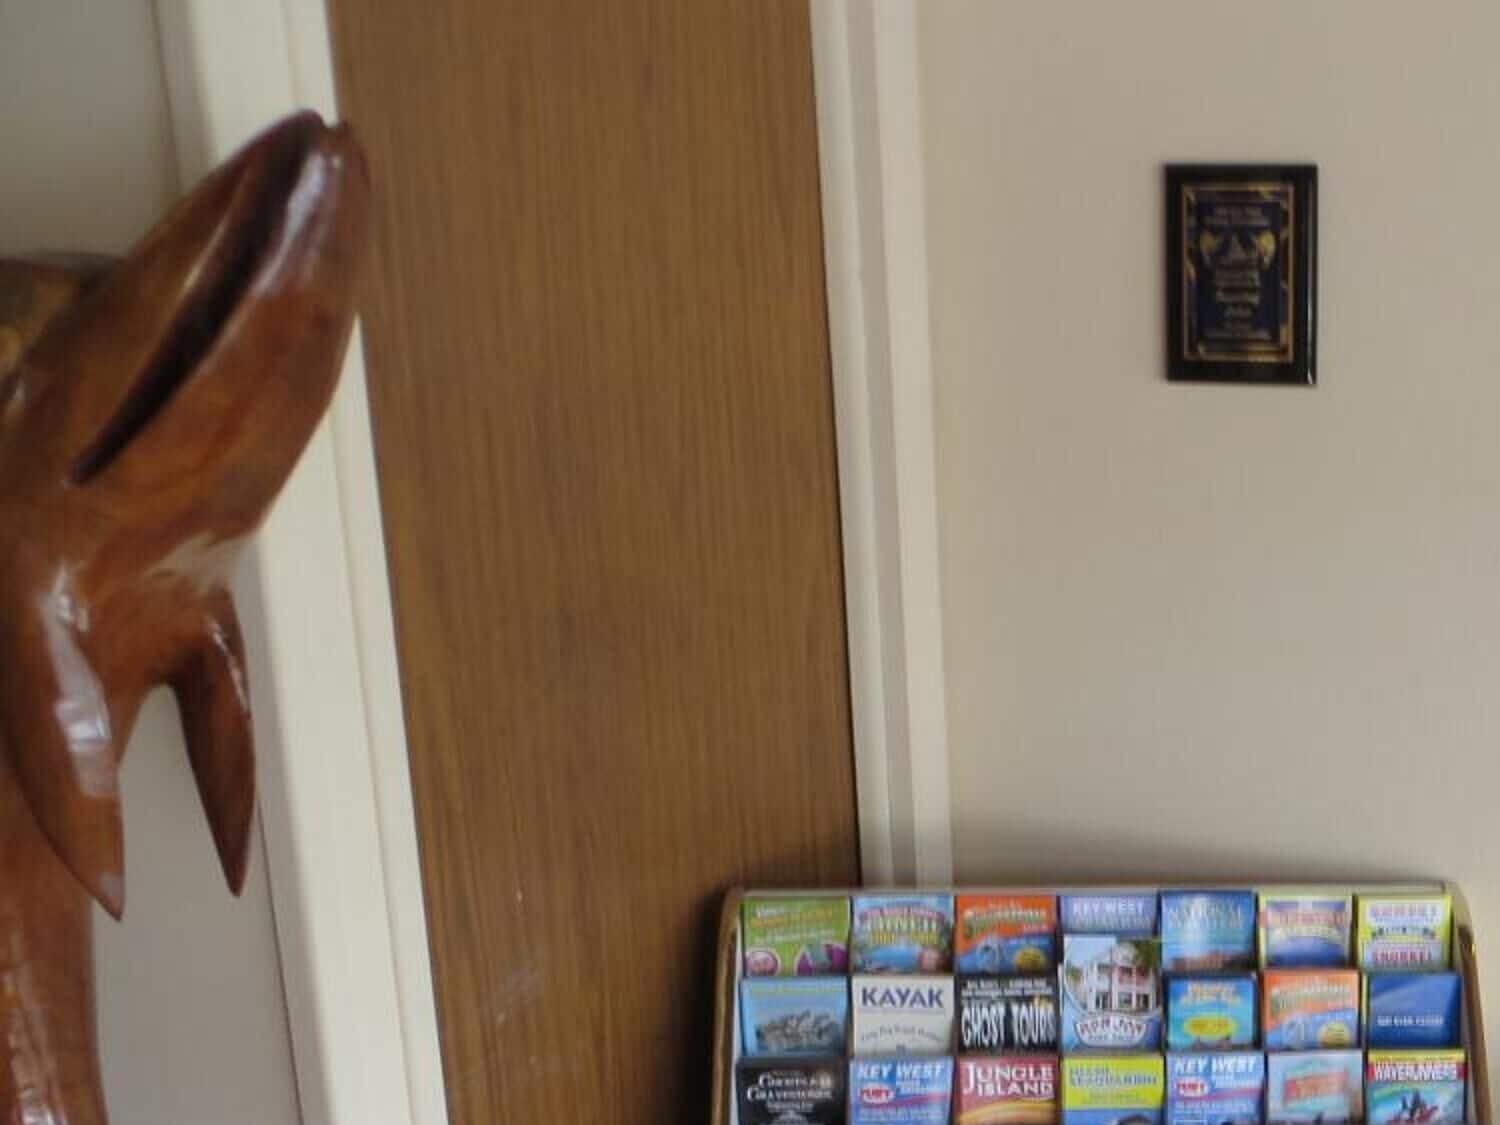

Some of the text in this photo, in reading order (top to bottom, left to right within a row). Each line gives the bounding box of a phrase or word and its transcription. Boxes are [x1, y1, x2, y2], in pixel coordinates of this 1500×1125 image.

[861, 987, 944, 1009] KAYAK
[961, 1001, 1057, 1048] GHOST TOURS
[858, 1062, 945, 1080] KEY WEST
[1175, 1055, 1255, 1074] KEY WEST
[962, 1060, 1055, 1096] JUNGLE
[977, 1082, 1055, 1098] ISLAND
